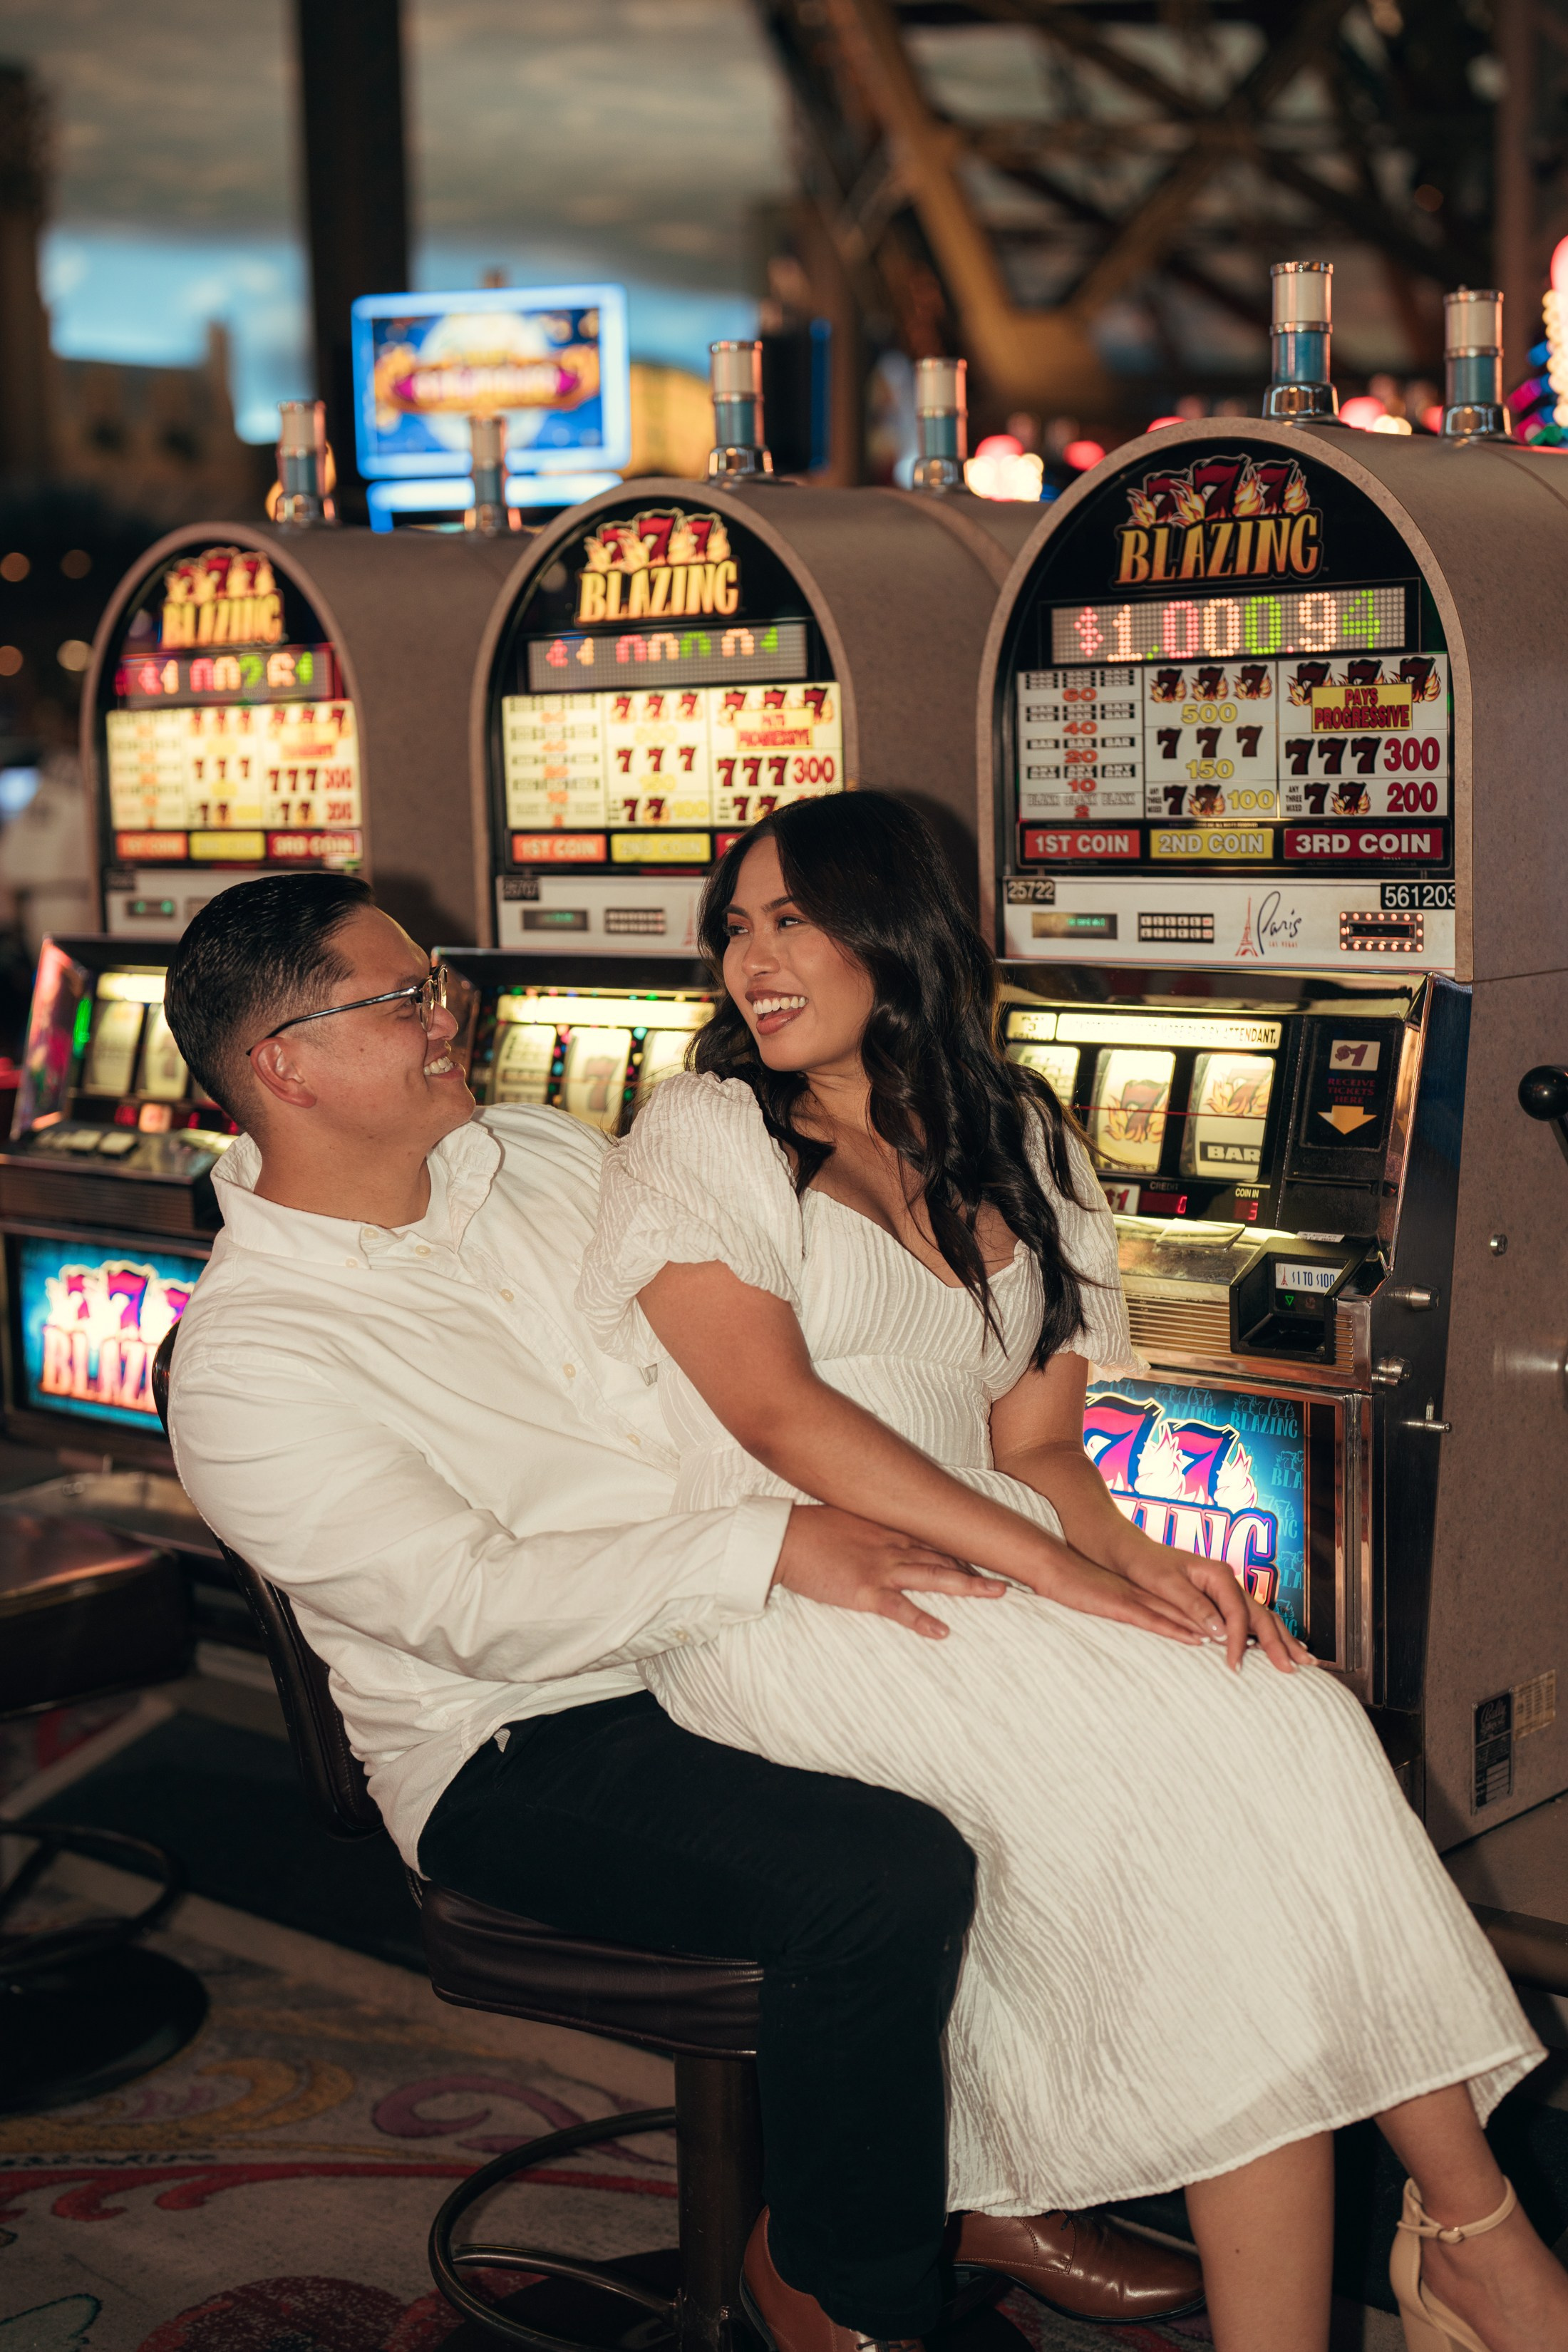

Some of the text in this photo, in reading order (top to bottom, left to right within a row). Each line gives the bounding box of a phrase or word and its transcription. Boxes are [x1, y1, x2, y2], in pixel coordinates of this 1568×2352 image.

[1113, 512, 1319, 584] BLAZING
[575, 559, 740, 624] BLAZING
[1063, 687, 1097, 702] 60
[1345, 688, 1378, 706] PAYS
[1182, 702, 1238, 723] 500
[1314, 704, 1410, 729] PROGRESSIVE
[1063, 721, 1098, 735] 40
[1157, 726, 1264, 759] 7 7 7
[1064, 749, 1098, 763] 20
[1285, 736, 1440, 775] 7 7 7 300
[718, 756, 835, 787] 7 7 7 300
[1186, 758, 1234, 779] 150
[1067, 778, 1097, 793] 10
[1163, 785, 1188, 815] 7
[1227, 789, 1274, 810] 100
[1304, 782, 1331, 815] 7
[1387, 781, 1438, 813] 200
[1075, 804, 1090, 818] 2
[1035, 834, 1130, 853] 1ST COIN
[1159, 834, 1264, 853] 2ND COIN
[1295, 833, 1431, 854] 3RD COIN
[1007, 881, 1055, 900] 25722
[1257, 891, 1303, 956] Paris
[1334, 1044, 1368, 1066] $1
[1328, 1078, 1376, 1088] RECEIVE
[1328, 1086, 1375, 1095] TICKETS
[1334, 1095, 1363, 1104] HERE
[1207, 1145, 1261, 1161] BAR
[1150, 1181, 1178, 1191] CREDIT
[1234, 1188, 1259, 1199] COIN IN
[1248, 1202, 1259, 1221] 3
[1303, 1272, 1313, 1286] TO
[1230, 1410, 1298, 1438] BLAZING
